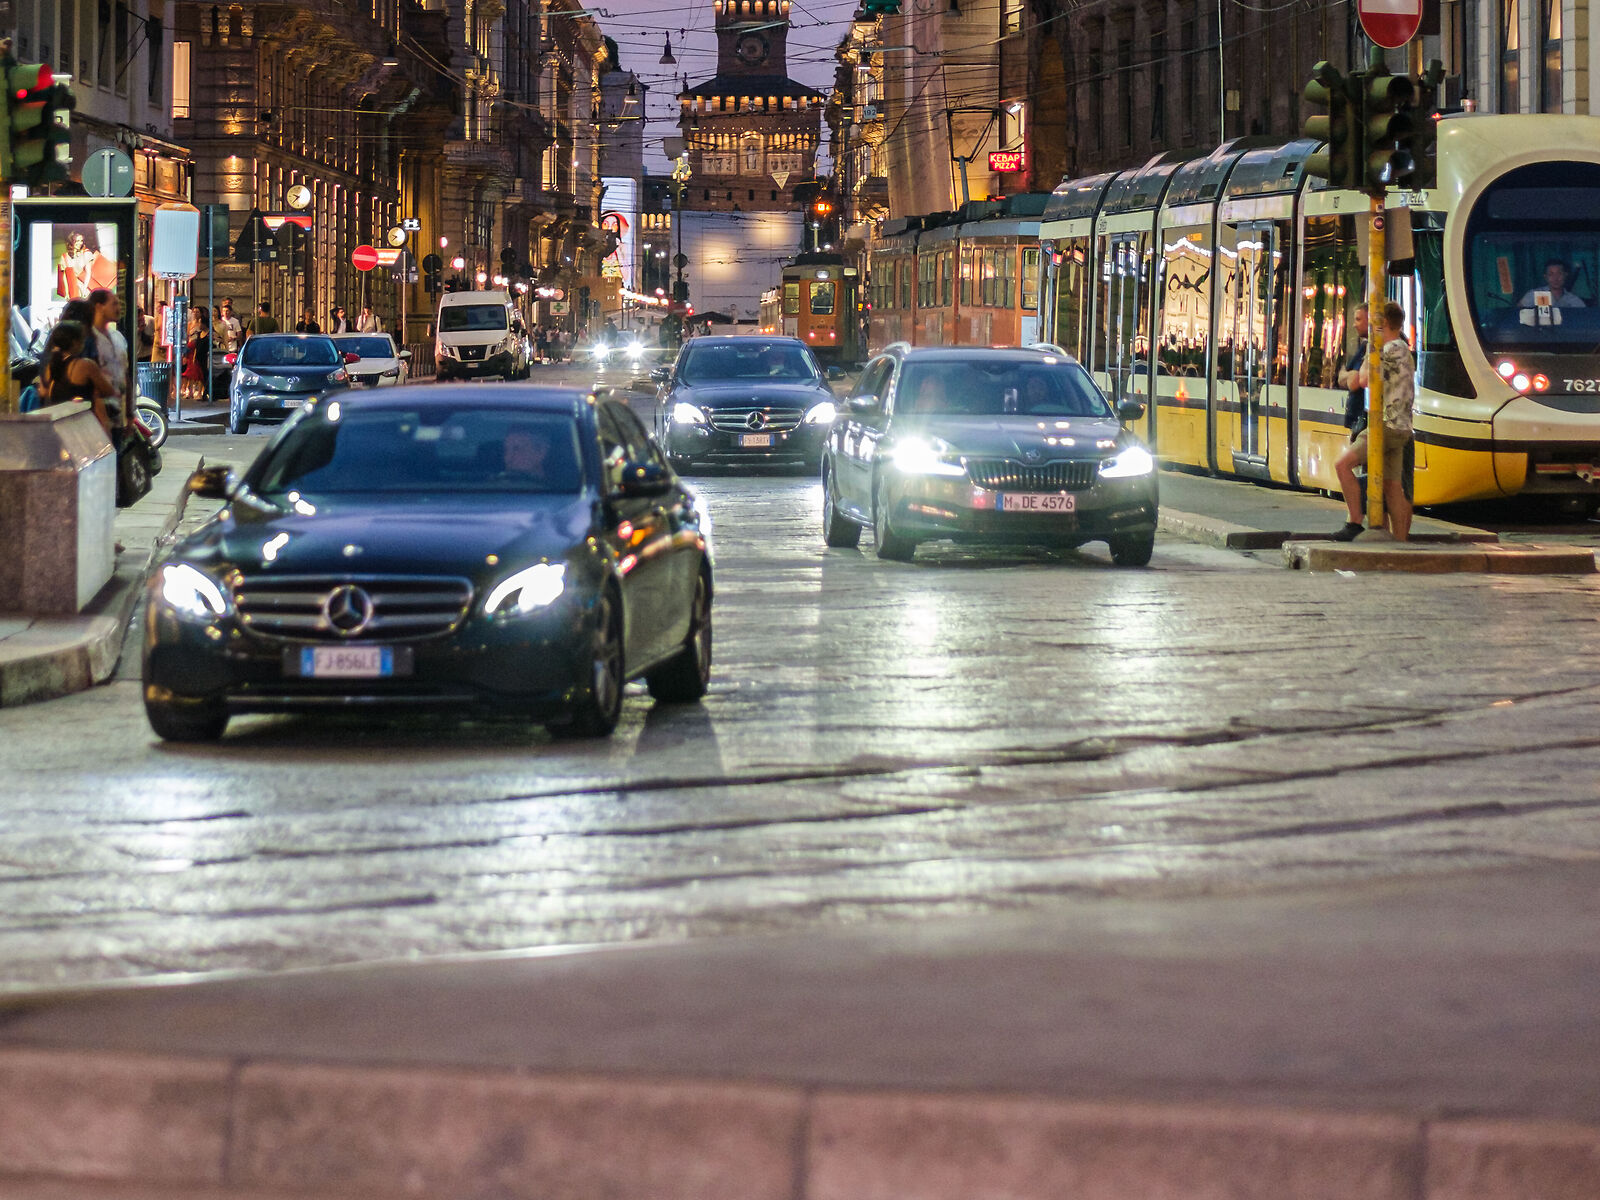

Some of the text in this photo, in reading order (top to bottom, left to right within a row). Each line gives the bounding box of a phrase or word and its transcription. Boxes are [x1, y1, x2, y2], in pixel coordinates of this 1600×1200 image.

[990, 153, 1021, 163] KEBAP
[1538, 306, 1549, 315] 14
[1022, 496, 1038, 508] DE
[1041, 497, 1073, 509] 4576
